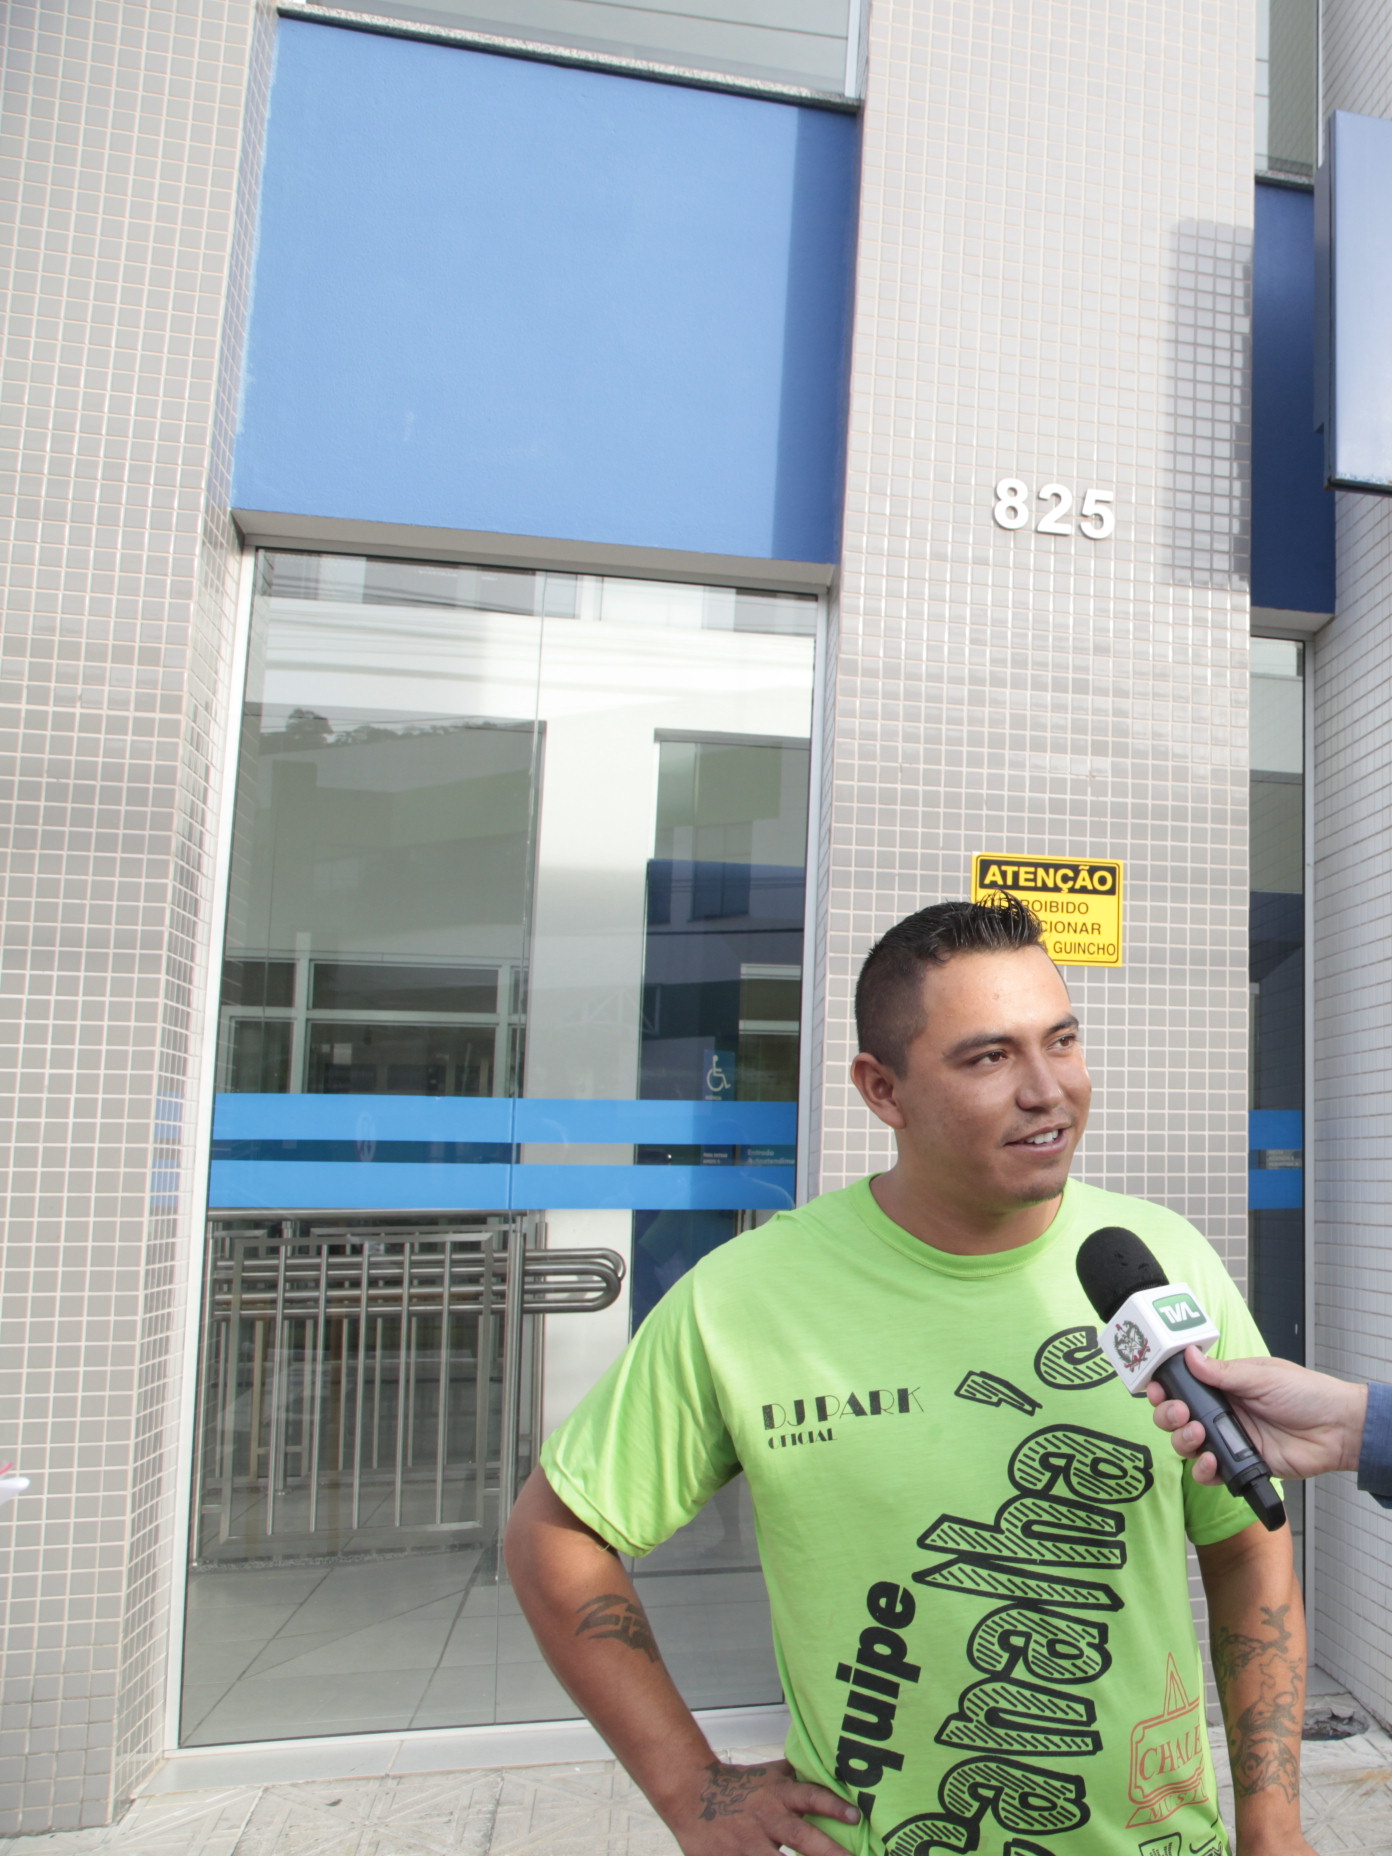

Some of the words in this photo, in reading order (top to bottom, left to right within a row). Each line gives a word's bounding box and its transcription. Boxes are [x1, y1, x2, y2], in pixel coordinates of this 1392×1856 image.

[992, 477, 1116, 540] 825
[983, 864, 1113, 893] ATENÇÃO
[1014, 899, 1090, 915] ROIBIDO
[1038, 920, 1102, 936] CIONAR
[1052, 940, 1117, 956] GUINCHO
[762, 1399, 806, 1431] DJ
[815, 1386, 925, 1422] PARK
[834, 1580, 922, 1830] quipe
